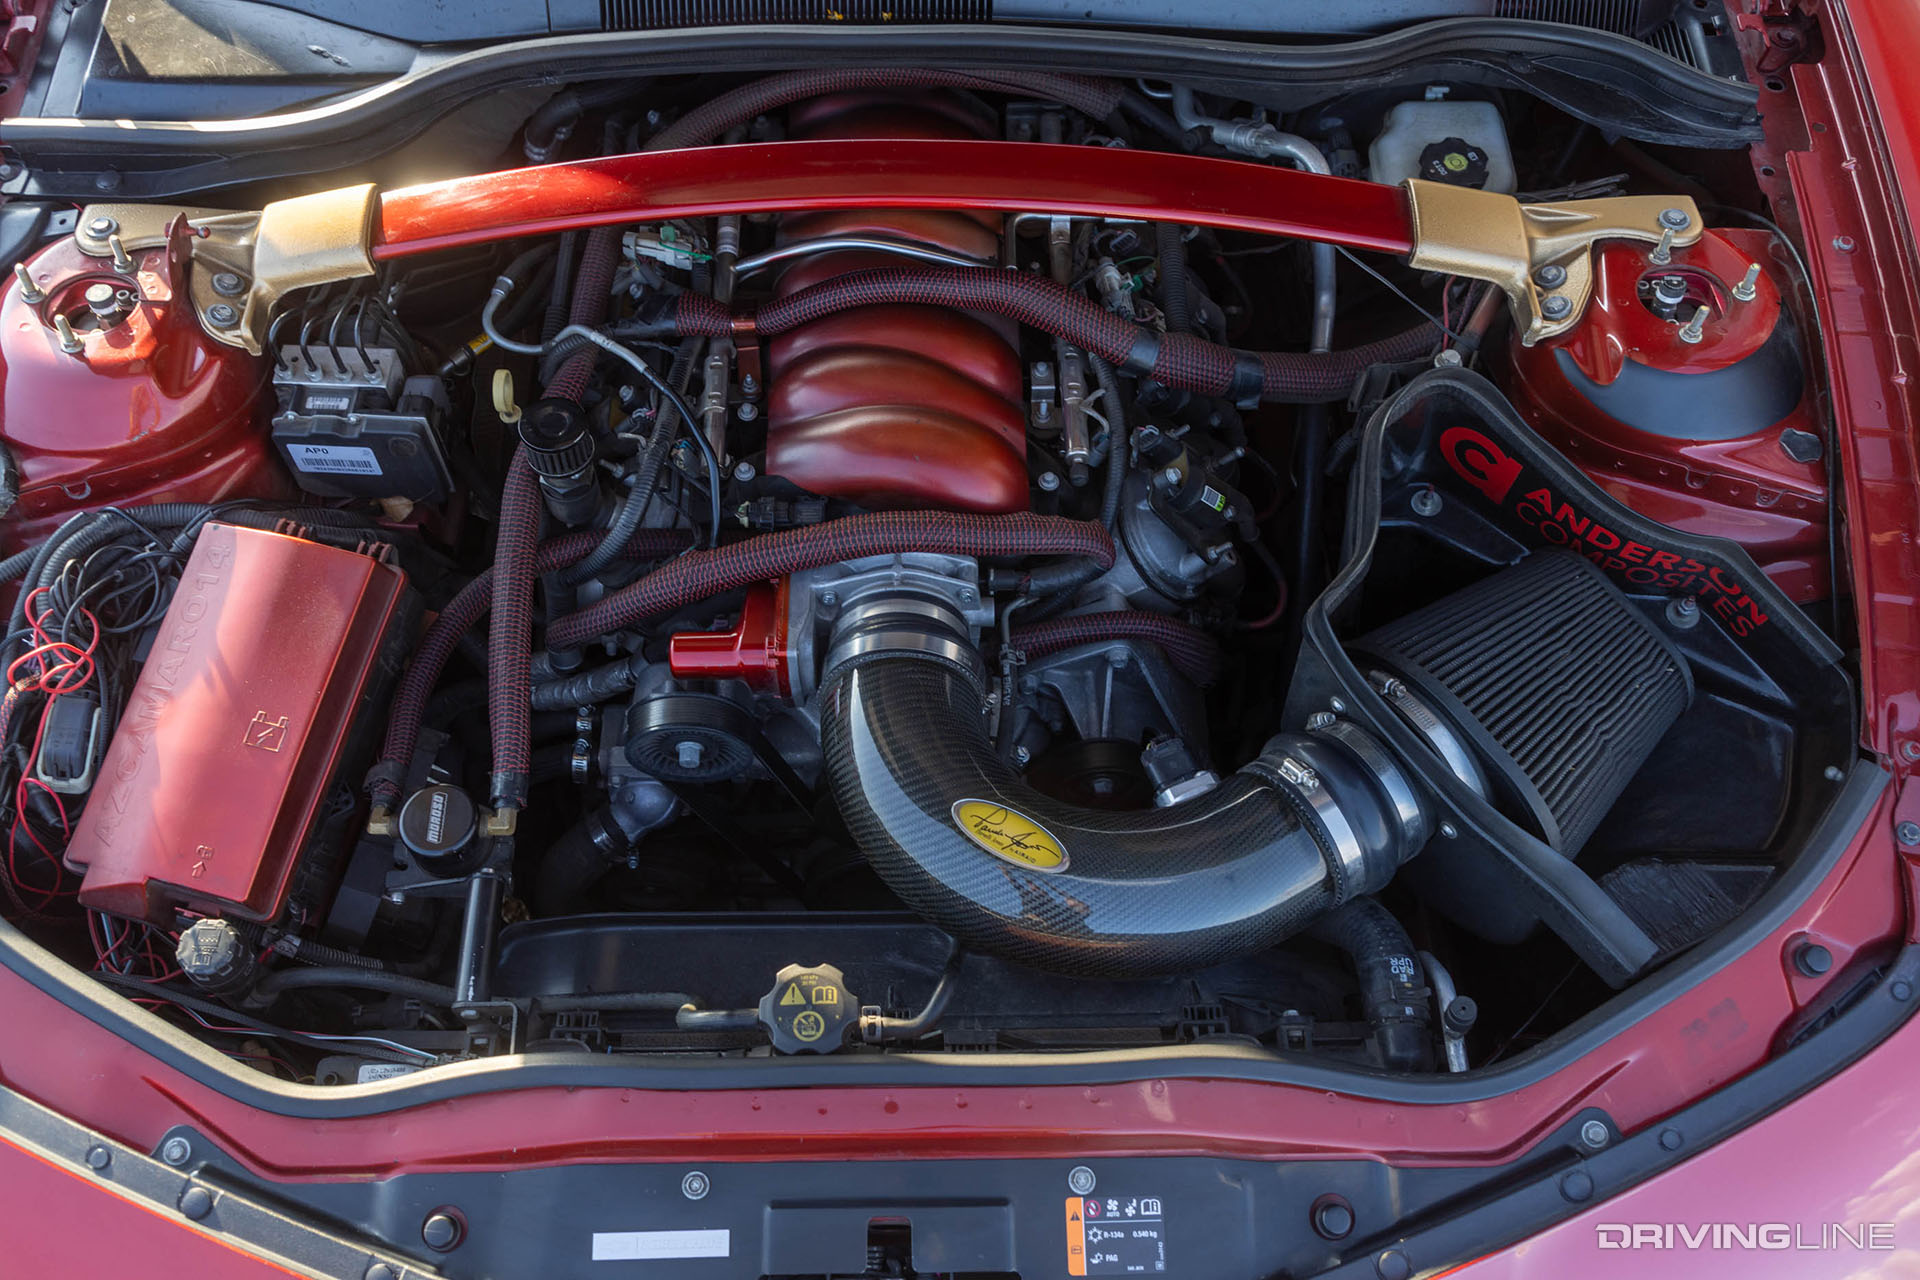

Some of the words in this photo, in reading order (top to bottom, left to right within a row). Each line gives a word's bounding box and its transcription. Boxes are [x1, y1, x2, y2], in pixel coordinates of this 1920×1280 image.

[1516, 502, 1755, 637] COMPOSITES
[1524, 488, 1768, 626] ANDERSON
[427, 793, 445, 842] MOROSO
